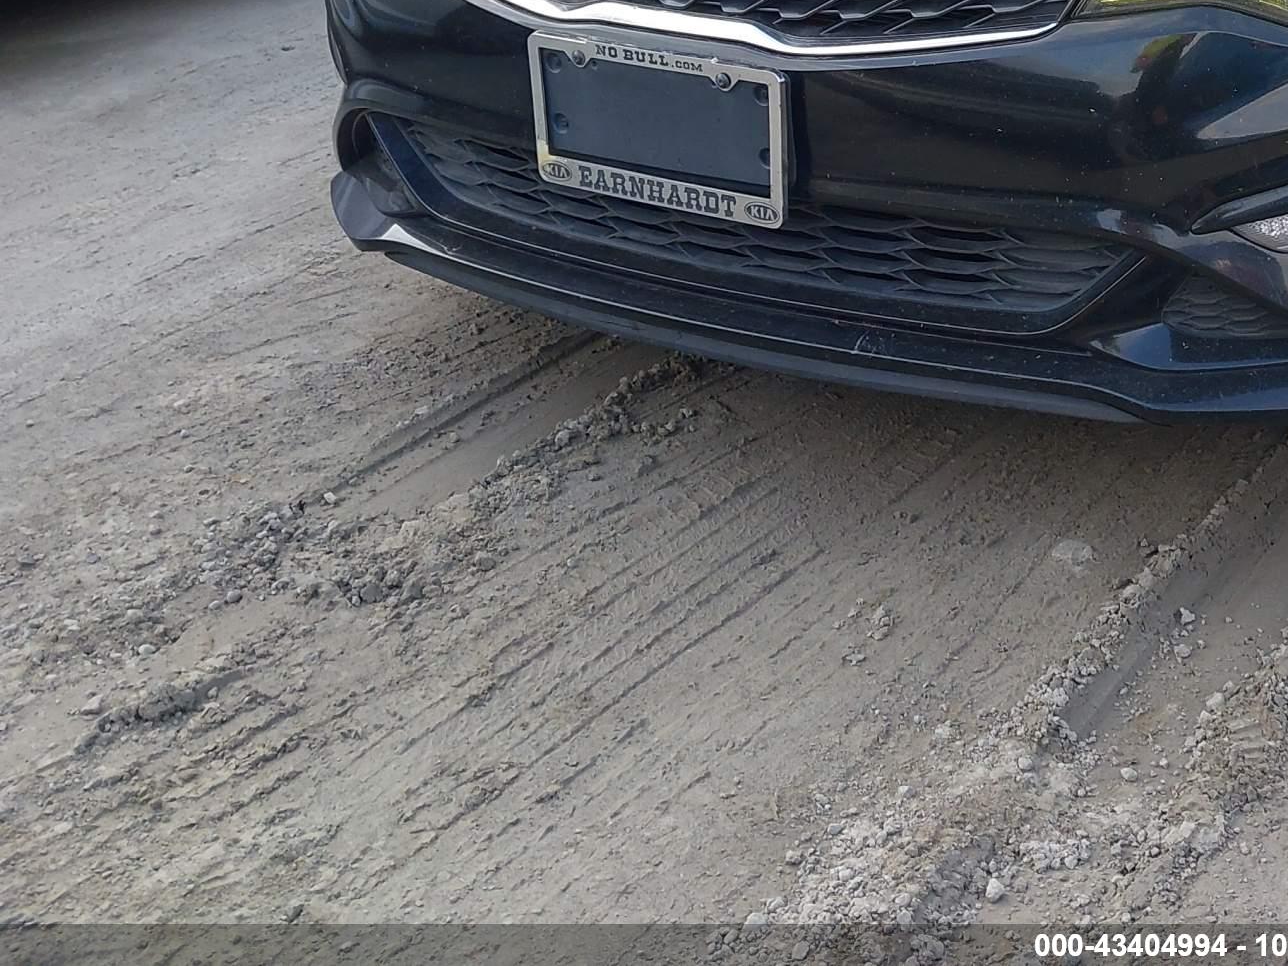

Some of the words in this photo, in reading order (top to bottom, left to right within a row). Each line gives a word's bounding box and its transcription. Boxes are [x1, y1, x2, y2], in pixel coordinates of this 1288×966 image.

[595, 44, 618, 59] NO
[542, 163, 569, 179] KIA
[578, 165, 737, 217] EARNHARDT
[749, 203, 776, 221] KIA
